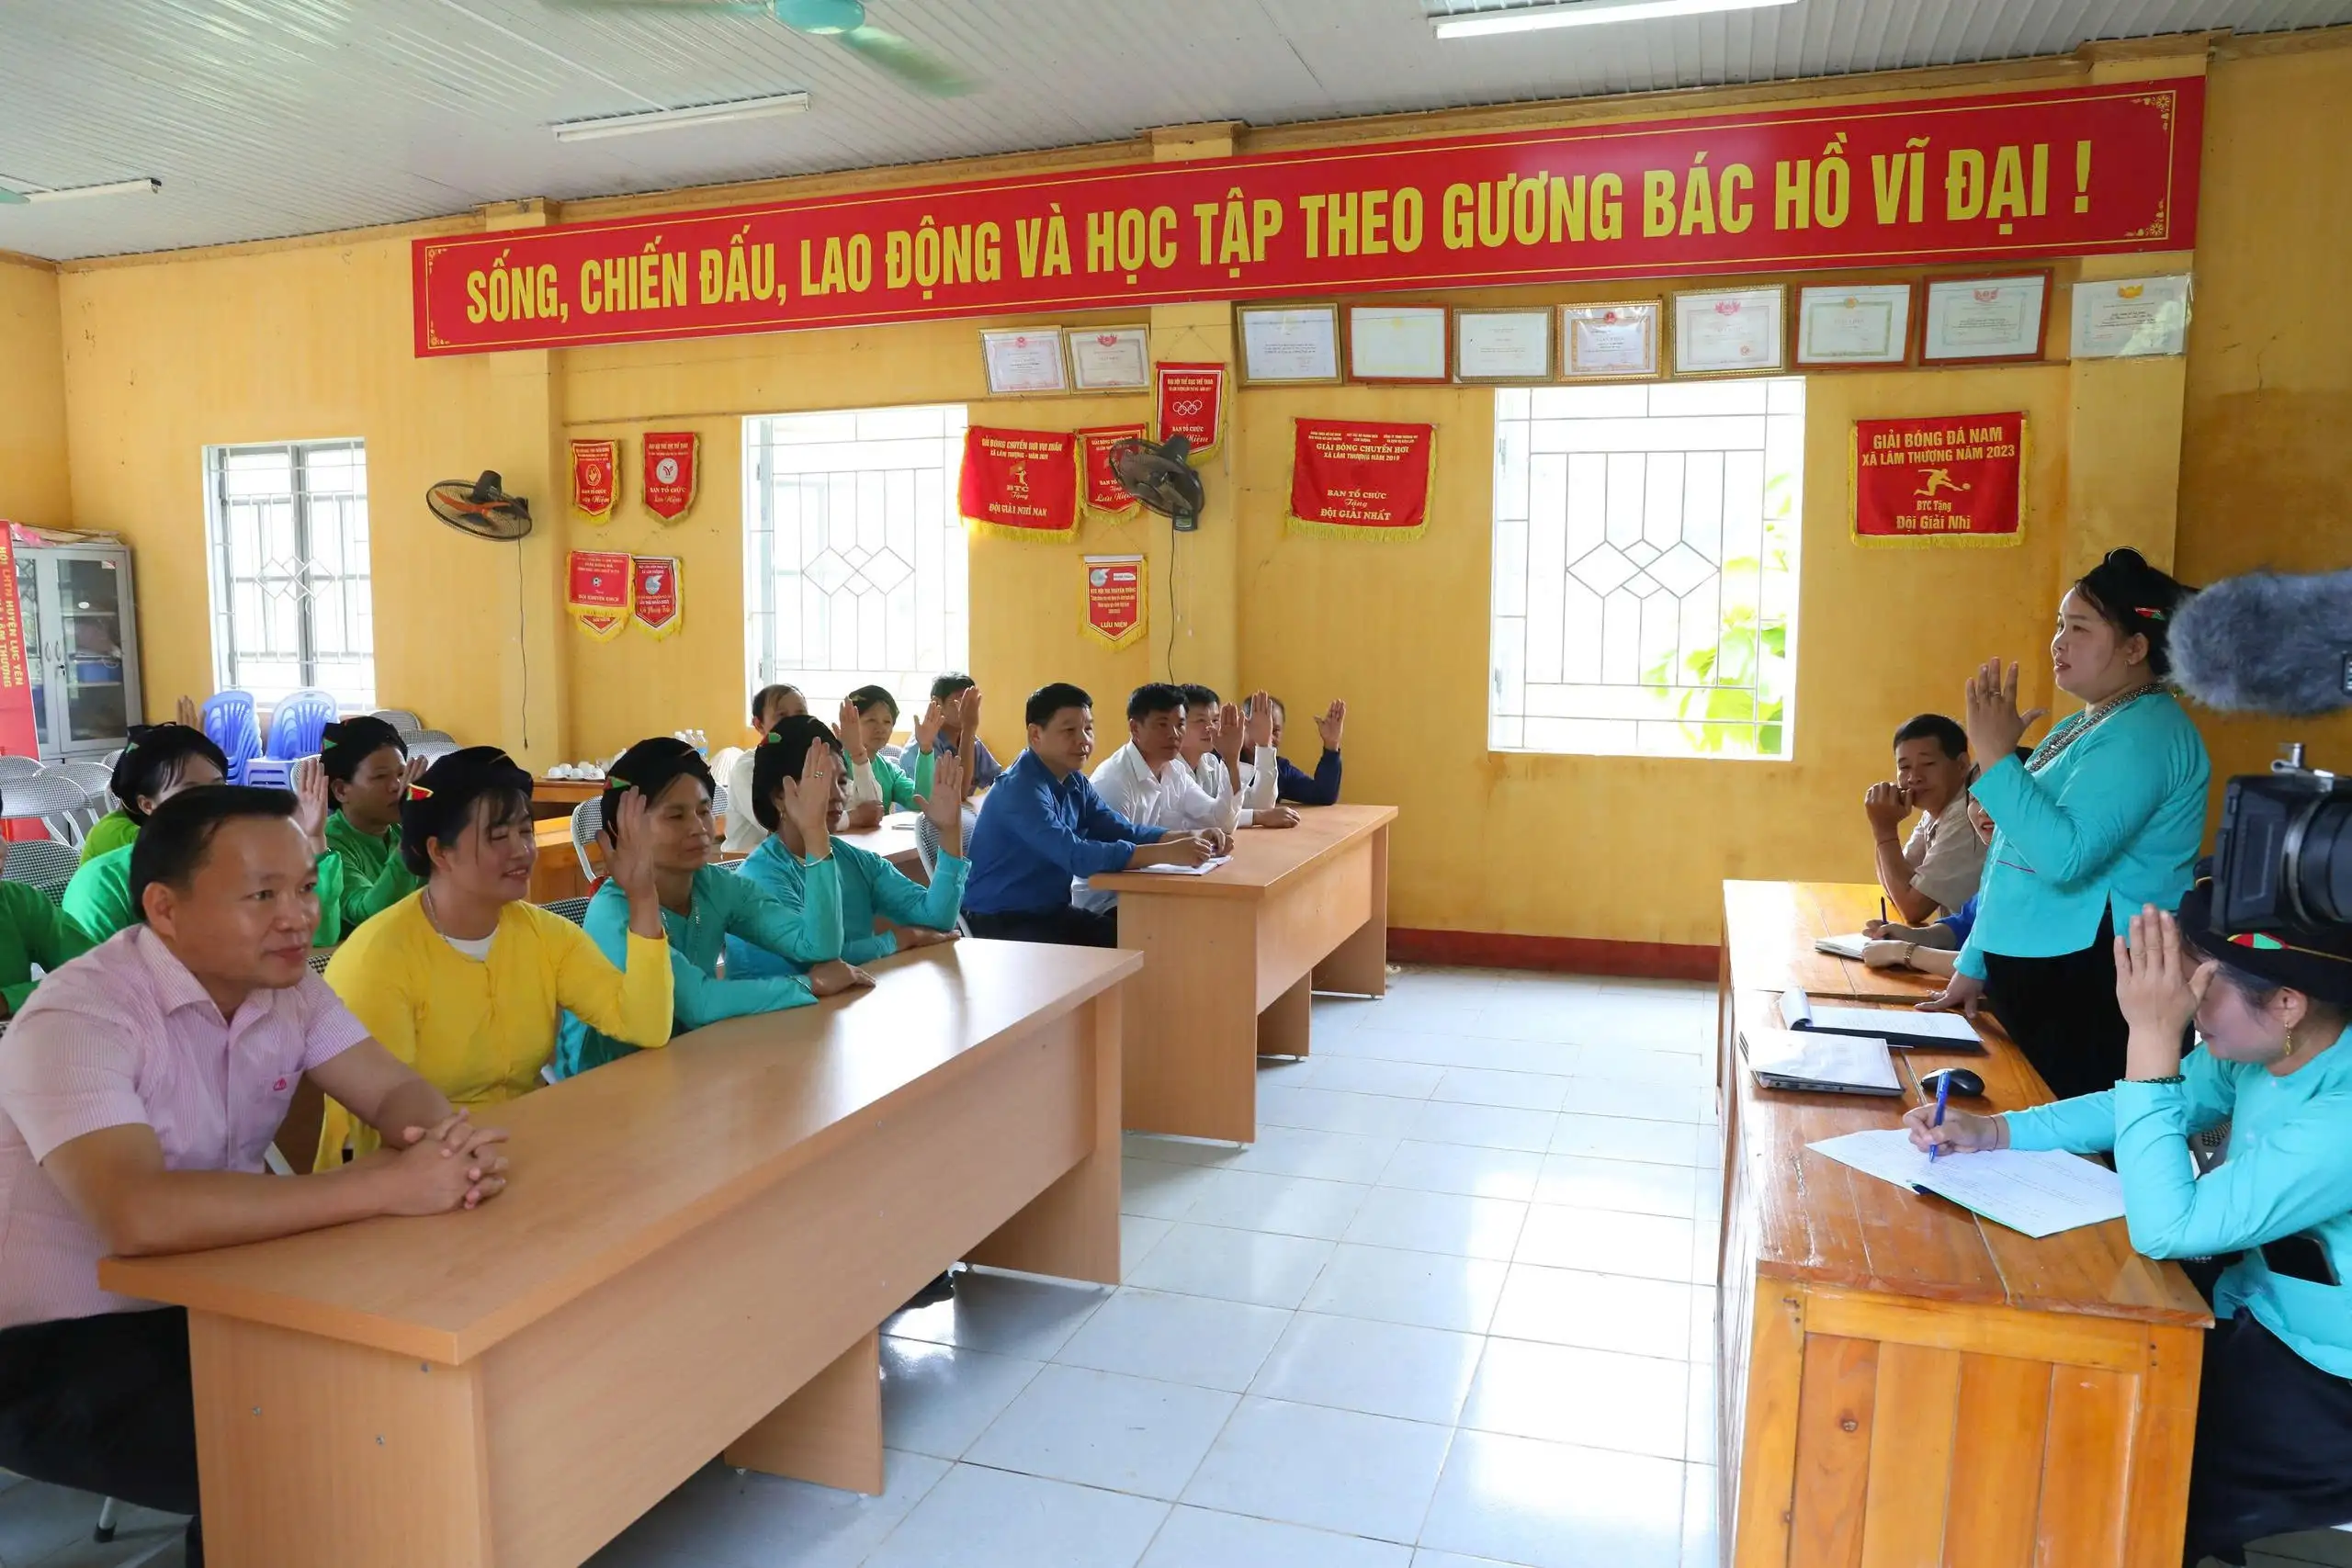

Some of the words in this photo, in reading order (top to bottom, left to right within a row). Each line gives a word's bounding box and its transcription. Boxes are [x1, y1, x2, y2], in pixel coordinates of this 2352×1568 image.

[467, 249, 569, 323] SỐNG,
[581, 236, 687, 315] CHIẾN
[698, 224, 787, 306] ĐẤU,
[800, 234, 872, 296] LAO
[885, 215, 1001, 300] ĐỘNG
[1015, 203, 1071, 278] VÀ
[1088, 206, 1178, 285] HỌC
[1193, 187, 1283, 278] TẬP
[1299, 186, 1424, 258] THEO
[1442, 170, 1623, 251] GƯƠNG
[1643, 152, 1754, 238] BÁC
[1775, 132, 1850, 231] HỒ
[1871, 136, 1931, 225] VĨ
[1945, 143, 2049, 235] ĐẠI
[2074, 140, 2092, 213] !
[1316, 442, 1334, 451] GIẢI
[1336, 442, 1358, 451] BÓNG
[1873, 429, 1901, 449] GIẢI
[1904, 429, 1943, 448] BÓNG
[1946, 427, 1966, 445] ĐÁ
[1969, 426, 2002, 444] NAM
[1861, 451, 1878, 467] XÃ
[1880, 450, 1905, 466] LÂM
[1907, 449, 1953, 466] THƯỢNG
[1956, 446, 1984, 460] NĂM
[1986, 444, 2015, 458] 2023
[1006, 484, 1029, 492] BTC
[1348, 489, 1361, 498] TỔ
[1363, 491, 1387, 500] CHỨC
[1320, 507, 1337, 519] ĐỘI
[1338, 507, 1363, 519] GIẢI
[1363, 508, 1392, 521] NHẤT
[1916, 500, 1932, 511] BTC
[1932, 500, 1952, 513] Tặng
[1895, 514, 1917, 532] Đội
[1919, 514, 1945, 529] Giải
[6, 600, 18, 637] HUYỆN
[9, 639, 20, 661] LỤC
[13, 663, 25, 686] YÊN
